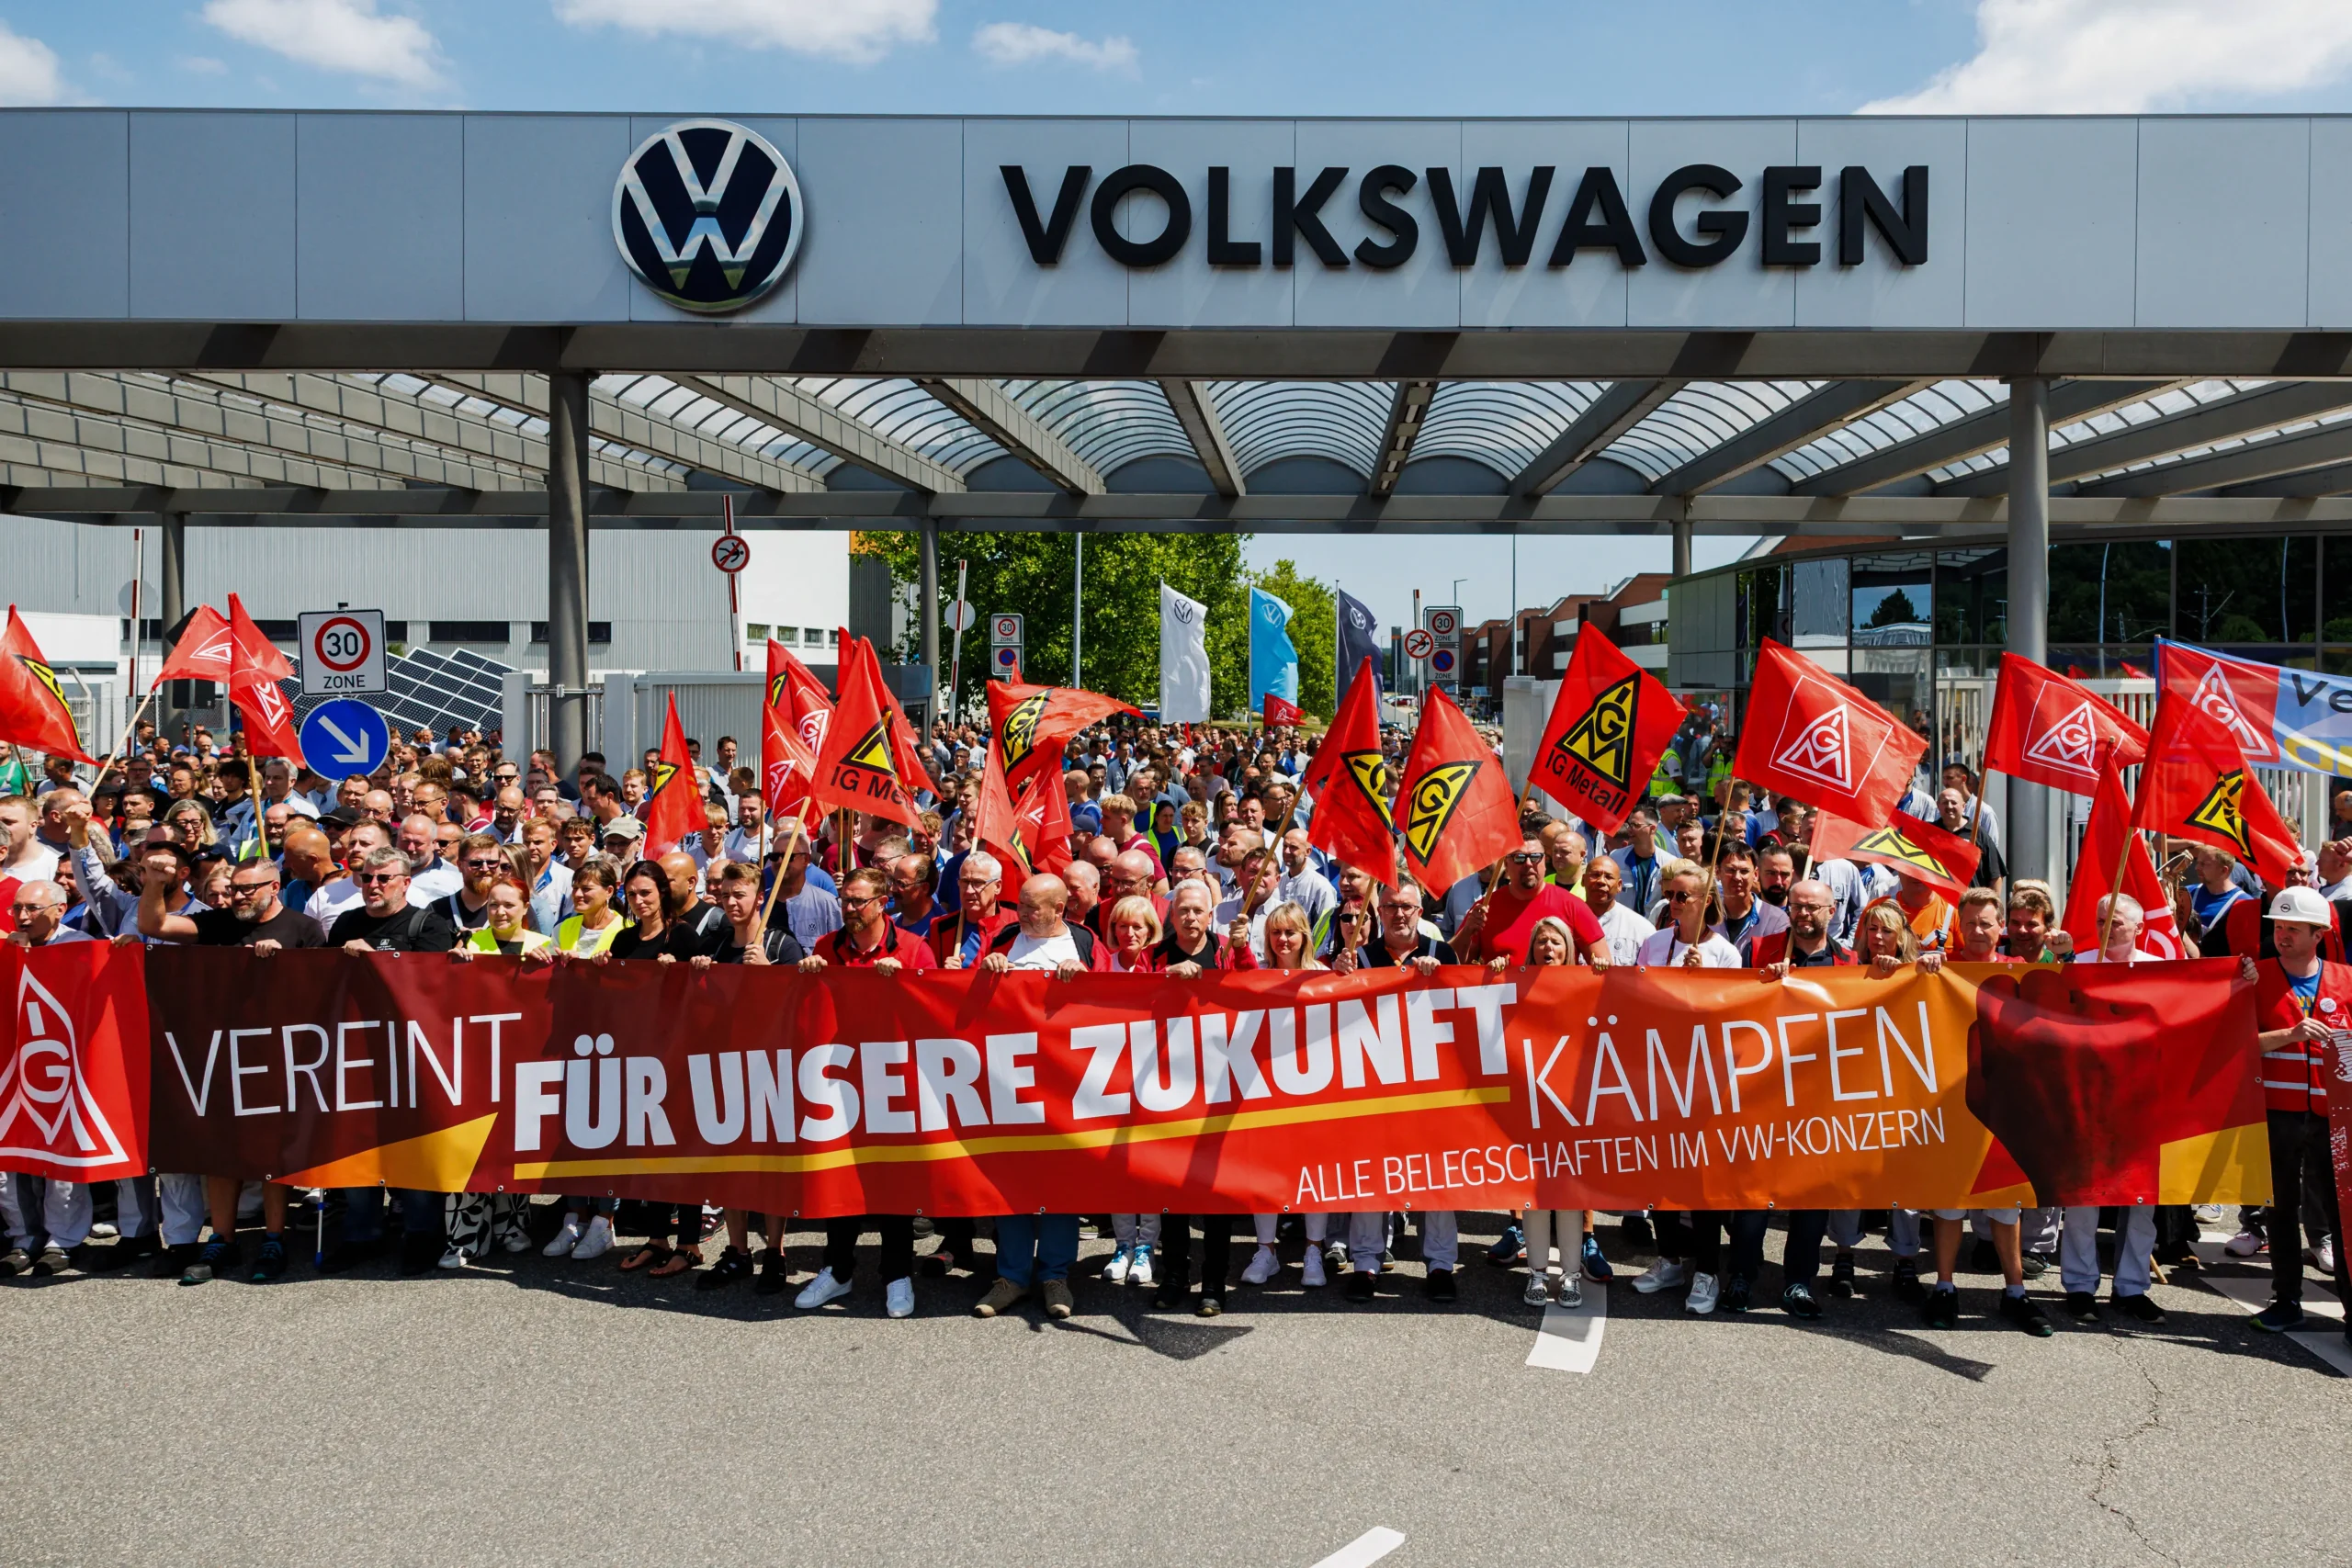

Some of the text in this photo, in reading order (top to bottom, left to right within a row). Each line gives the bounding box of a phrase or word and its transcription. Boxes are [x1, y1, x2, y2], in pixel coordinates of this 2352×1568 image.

[999, 164, 1928, 274] VOLKSWAGEN
[1001, 623, 1012, 632] 30
[1436, 617, 1451, 628] 30
[325, 632, 359, 657] 30
[323, 674, 366, 689] ZONE
[830, 765, 861, 792] IG
[1544, 749, 1629, 816] IG Metall
[165, 982, 1939, 1152] VEREINT FÜR UNSERE ZUKUNFT KÄMPFEN
[1295, 1107, 1945, 1205] ALLE BELEGSCHAFTEN IM VW-KONZERN
